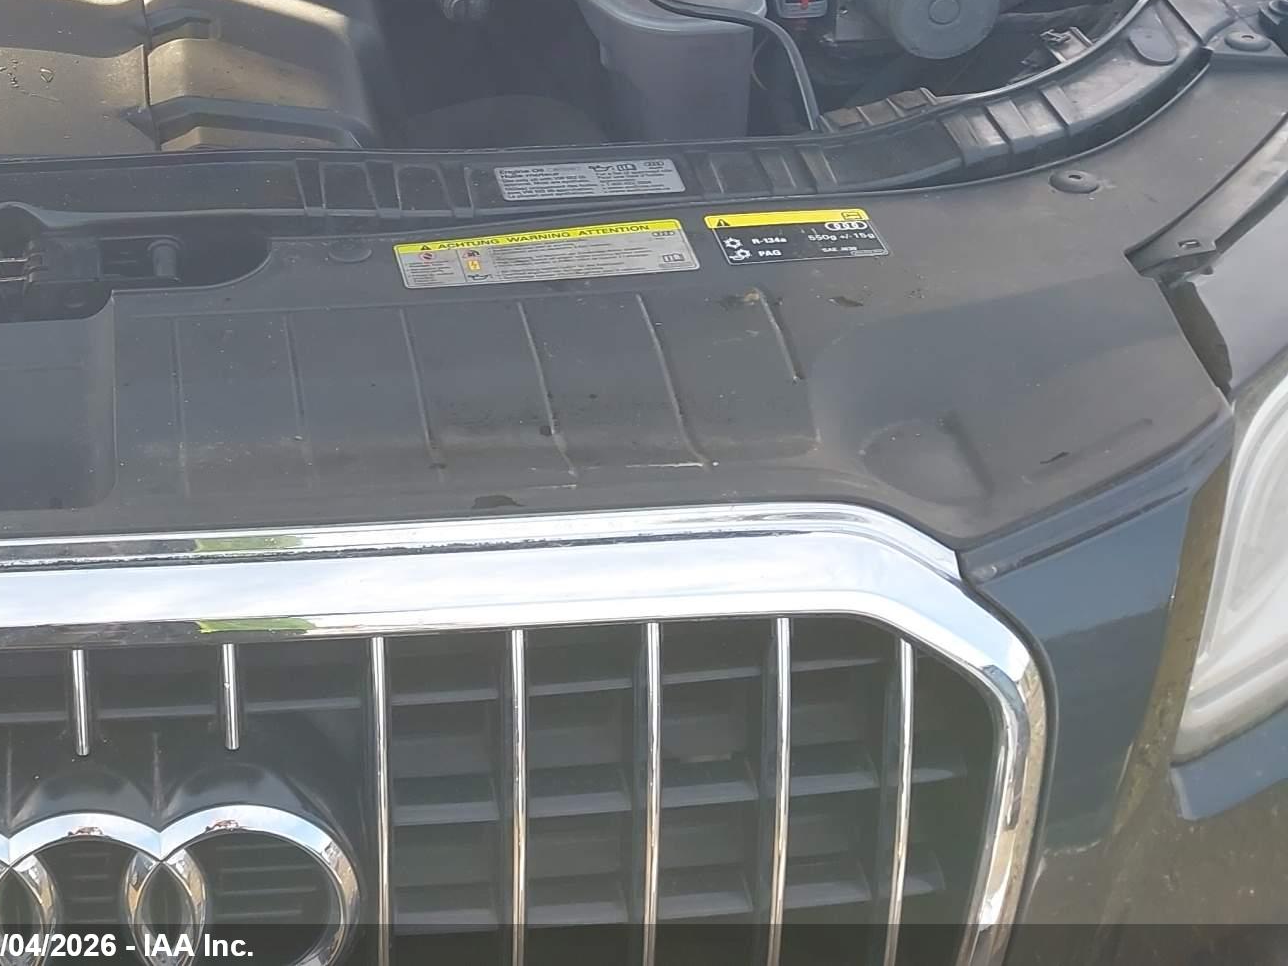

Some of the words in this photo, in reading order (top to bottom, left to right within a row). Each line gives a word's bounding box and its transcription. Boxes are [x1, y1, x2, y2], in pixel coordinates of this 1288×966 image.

[437, 238, 500, 250] ACHTUNG
[506, 231, 570, 242] WARNING
[578, 225, 650, 236] ATTENTION
[751, 237, 787, 245] R-134a
[808, 233, 837, 242] 550g
[758, 249, 782, 257] PAG
